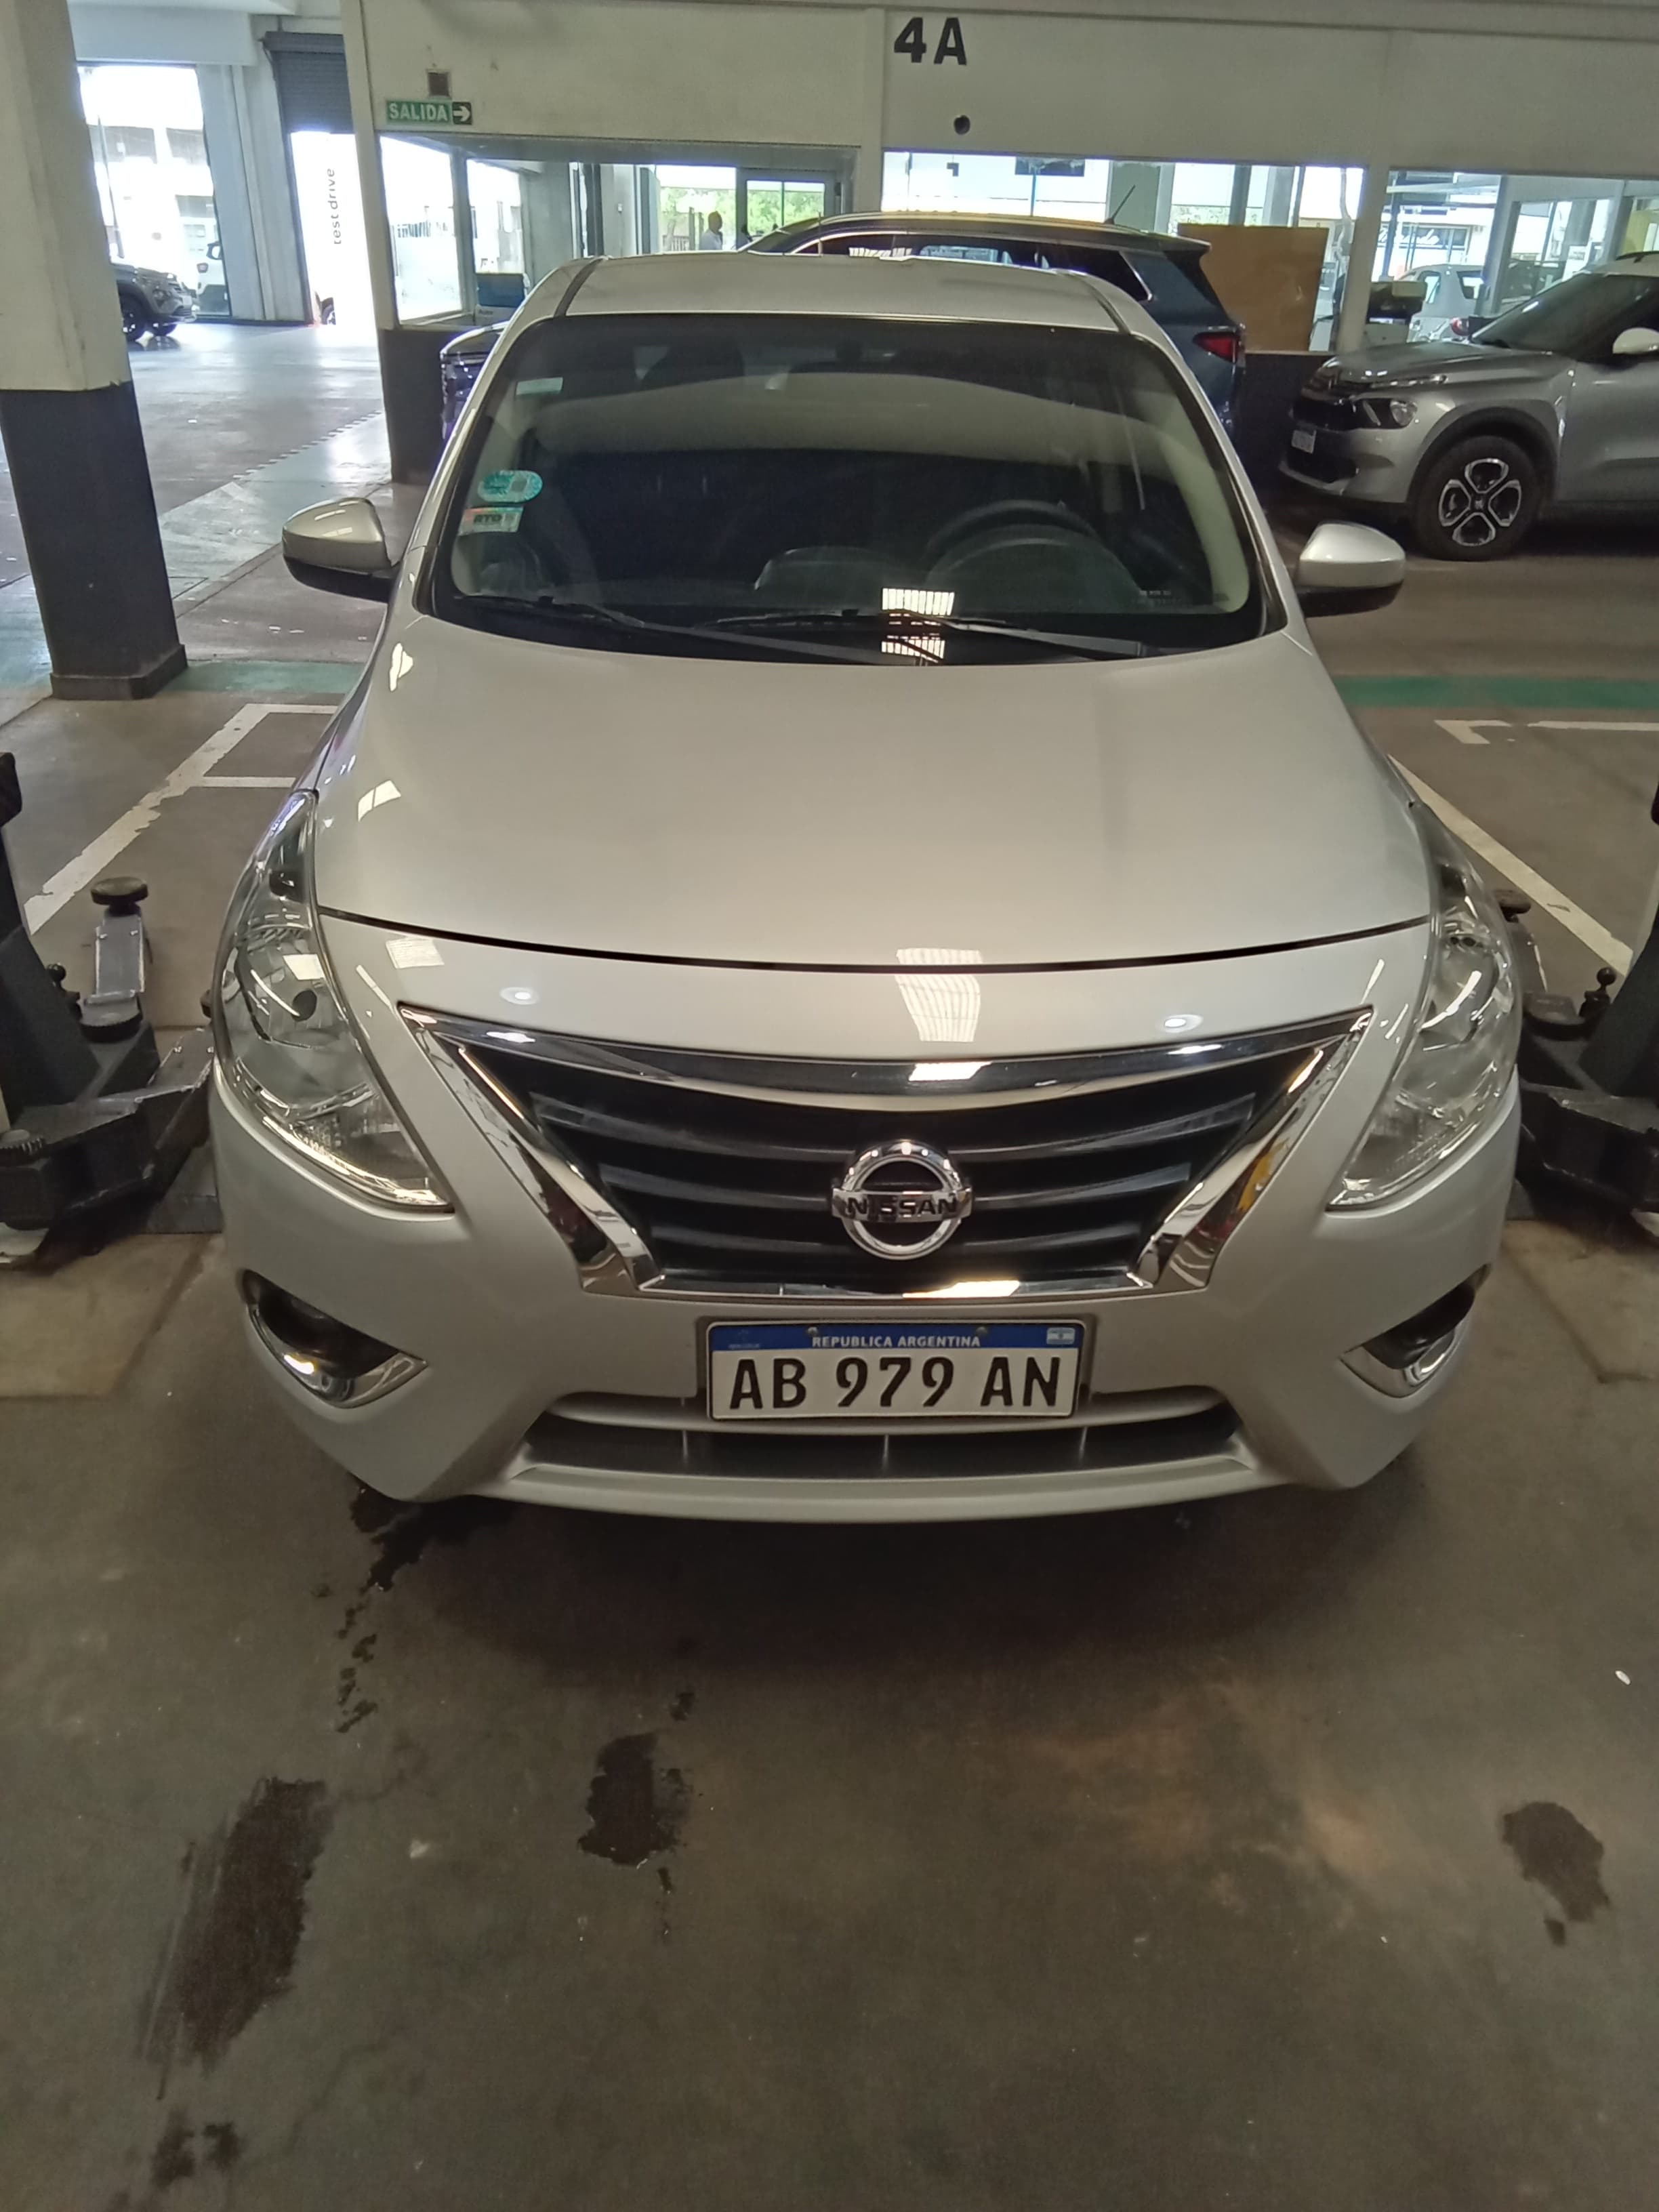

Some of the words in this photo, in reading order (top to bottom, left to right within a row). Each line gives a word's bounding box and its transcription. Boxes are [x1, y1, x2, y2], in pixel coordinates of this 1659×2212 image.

[894, 17, 967, 66] 4A
[389, 102, 448, 121] SALIDA
[327, 168, 338, 209] drive
[331, 213, 342, 245] test
[847, 1197, 958, 1217] NISSAN
[812, 1336, 893, 1348] REPUBLICA
[897, 1336, 981, 1347] ARGENTINA
[729, 1357, 807, 1410] AB
[836, 1356, 954, 1408] 979
[980, 1356, 1061, 1408] AN
